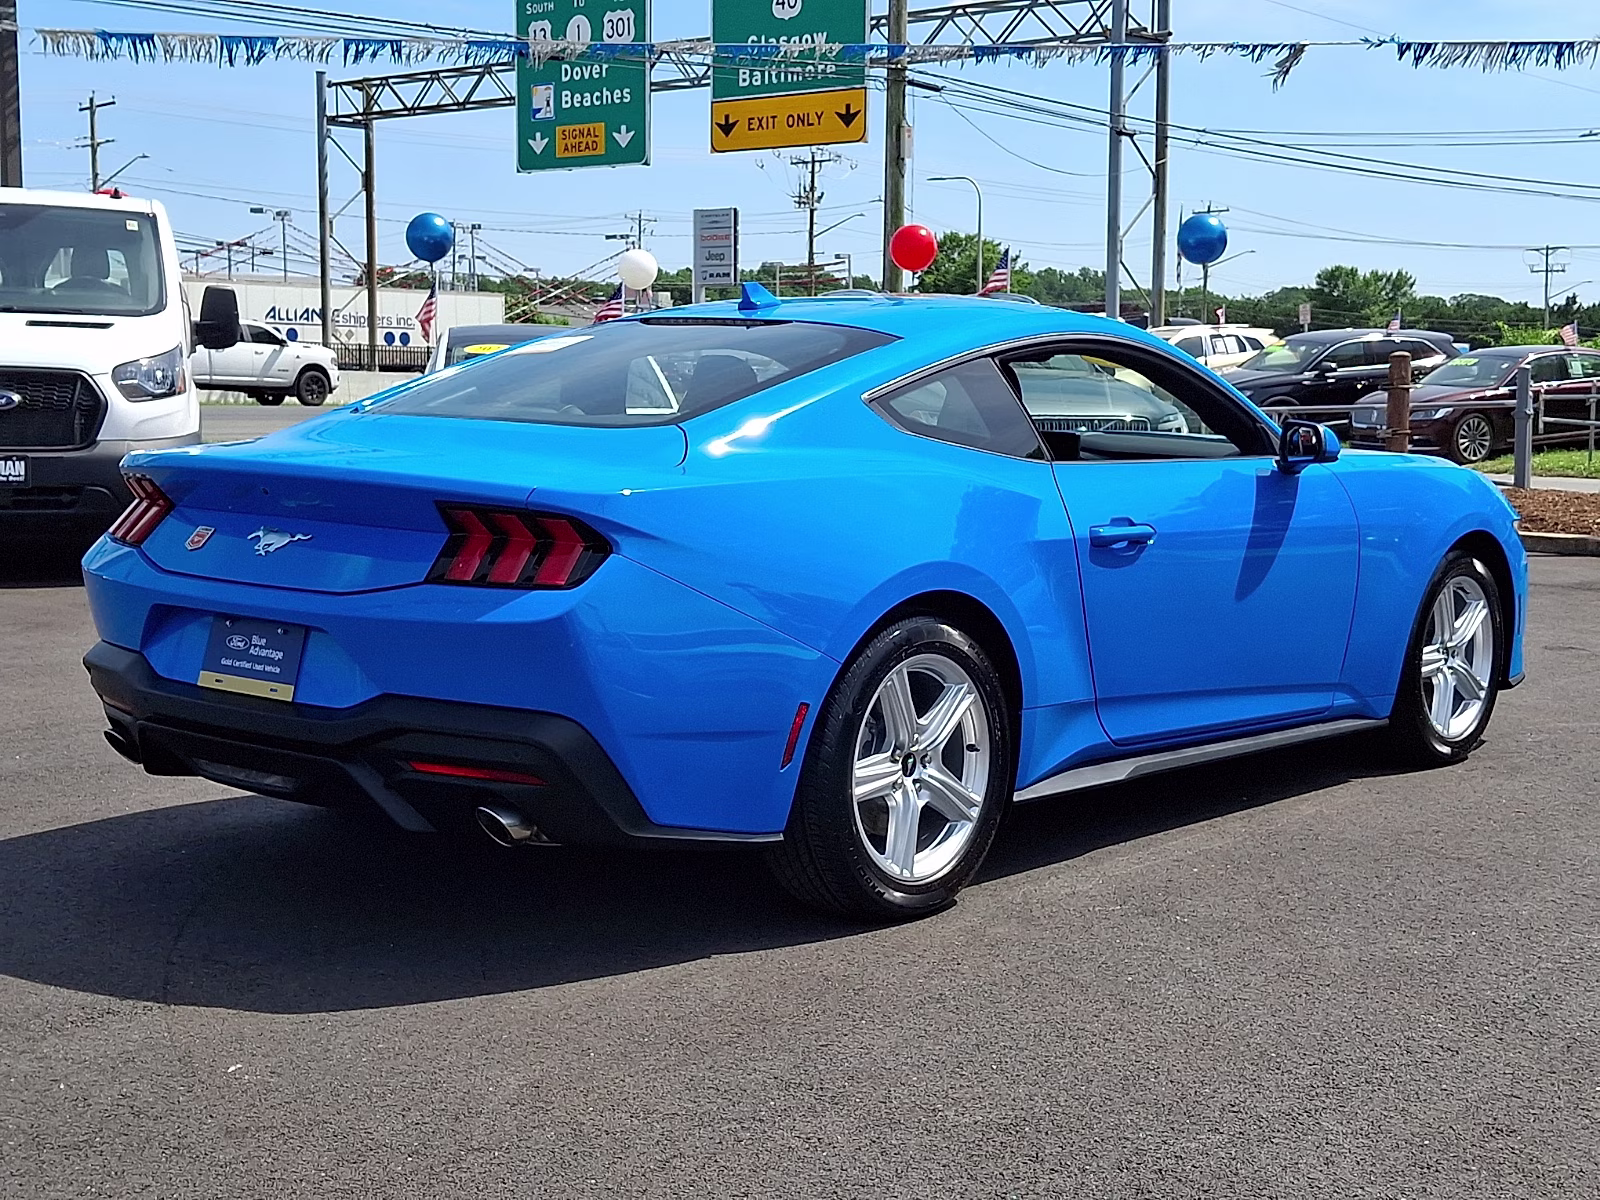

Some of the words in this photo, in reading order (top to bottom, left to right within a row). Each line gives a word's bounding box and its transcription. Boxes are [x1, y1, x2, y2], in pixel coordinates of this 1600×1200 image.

[525, 1, 555, 15] SOUTH
[606, 16, 632, 39] 301
[562, 64, 609, 81] Dover
[738, 63, 837, 87] Baltimore
[561, 87, 632, 109] Beaches
[747, 115, 778, 131] EXIT
[785, 111, 825, 128] ONLY
[561, 127, 600, 141] SIGNAL
[562, 140, 599, 154] AHEAD
[705, 250, 725, 262] Jeep
[396, 313, 416, 327] inc.
[230, 636, 246, 648] Ford
[252, 635, 266, 646] Blue
[249, 646, 283, 660] Advantage
[221, 657, 232, 665] Gold
[233, 660, 252, 669] Certified
